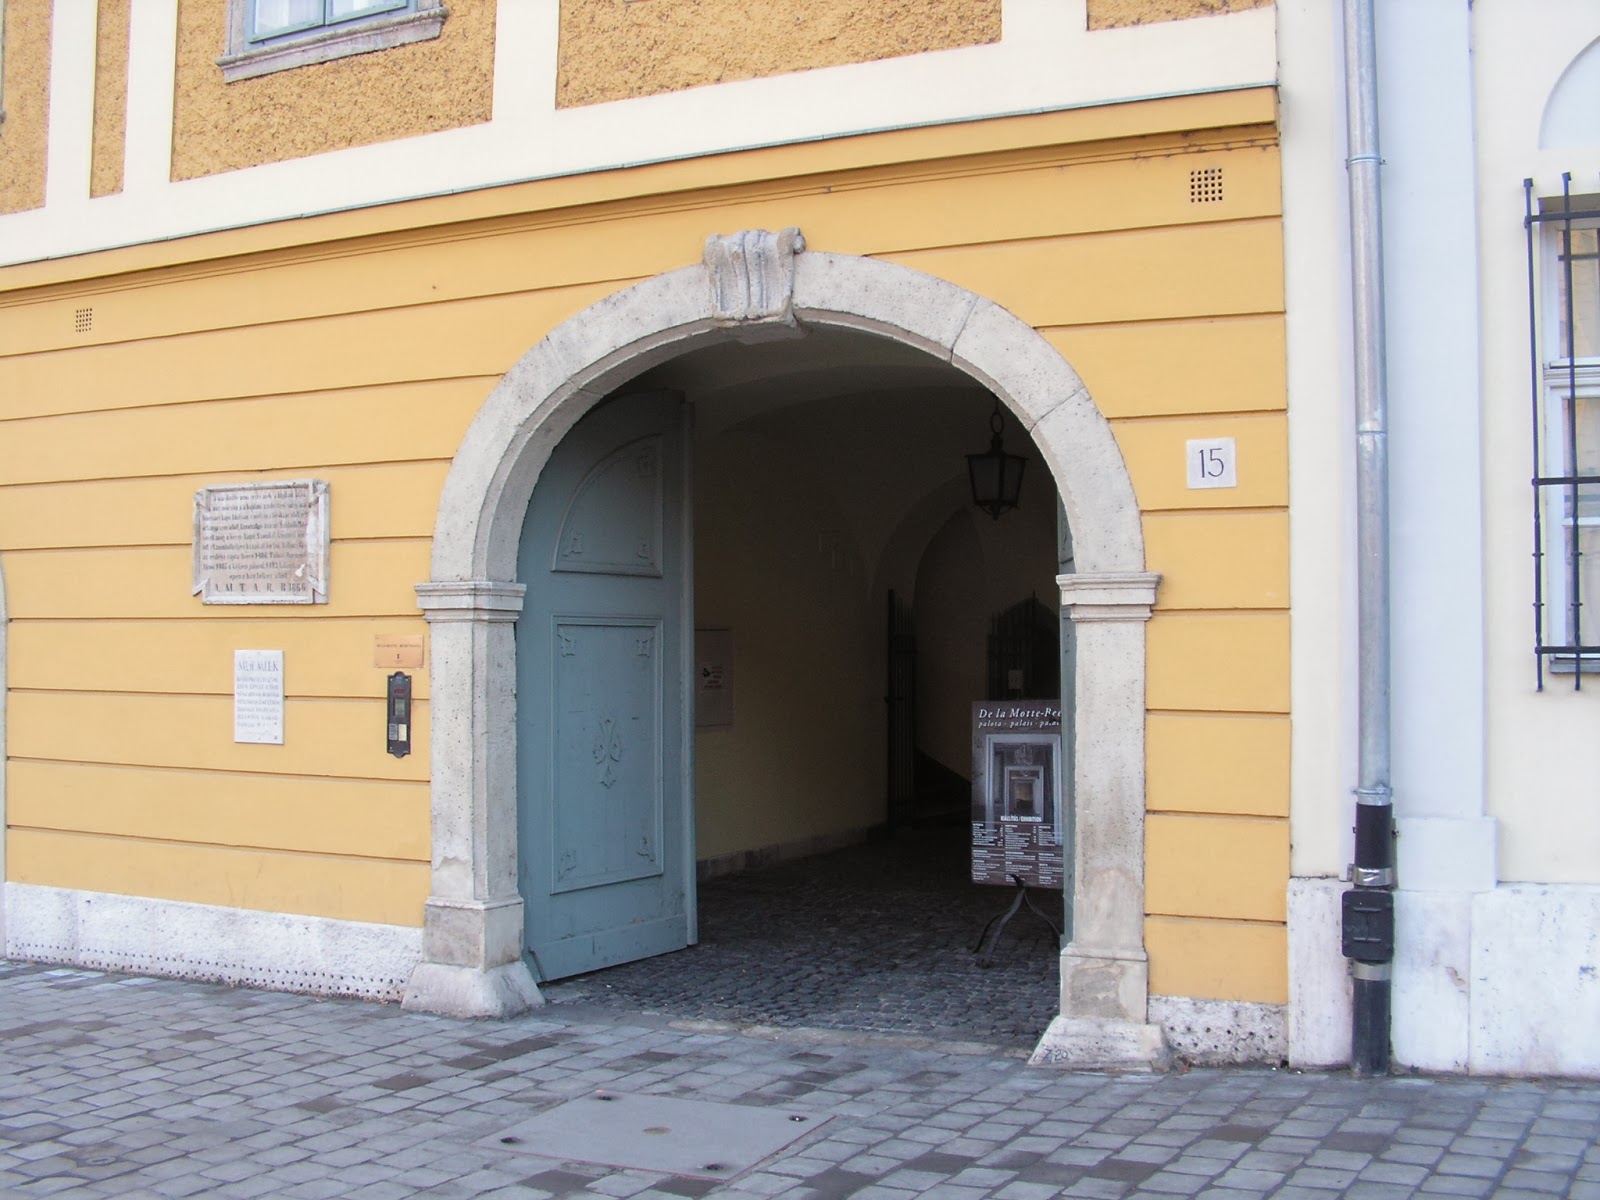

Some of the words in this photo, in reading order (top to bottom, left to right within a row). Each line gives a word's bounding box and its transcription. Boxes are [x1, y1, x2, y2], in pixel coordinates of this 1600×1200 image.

[1198, 448, 1225, 479] 15
[978, 708, 993, 719] De
[995, 707, 1006, 719] la
[978, 720, 1002, 729] palota
[1009, 719, 1033, 729] palais
